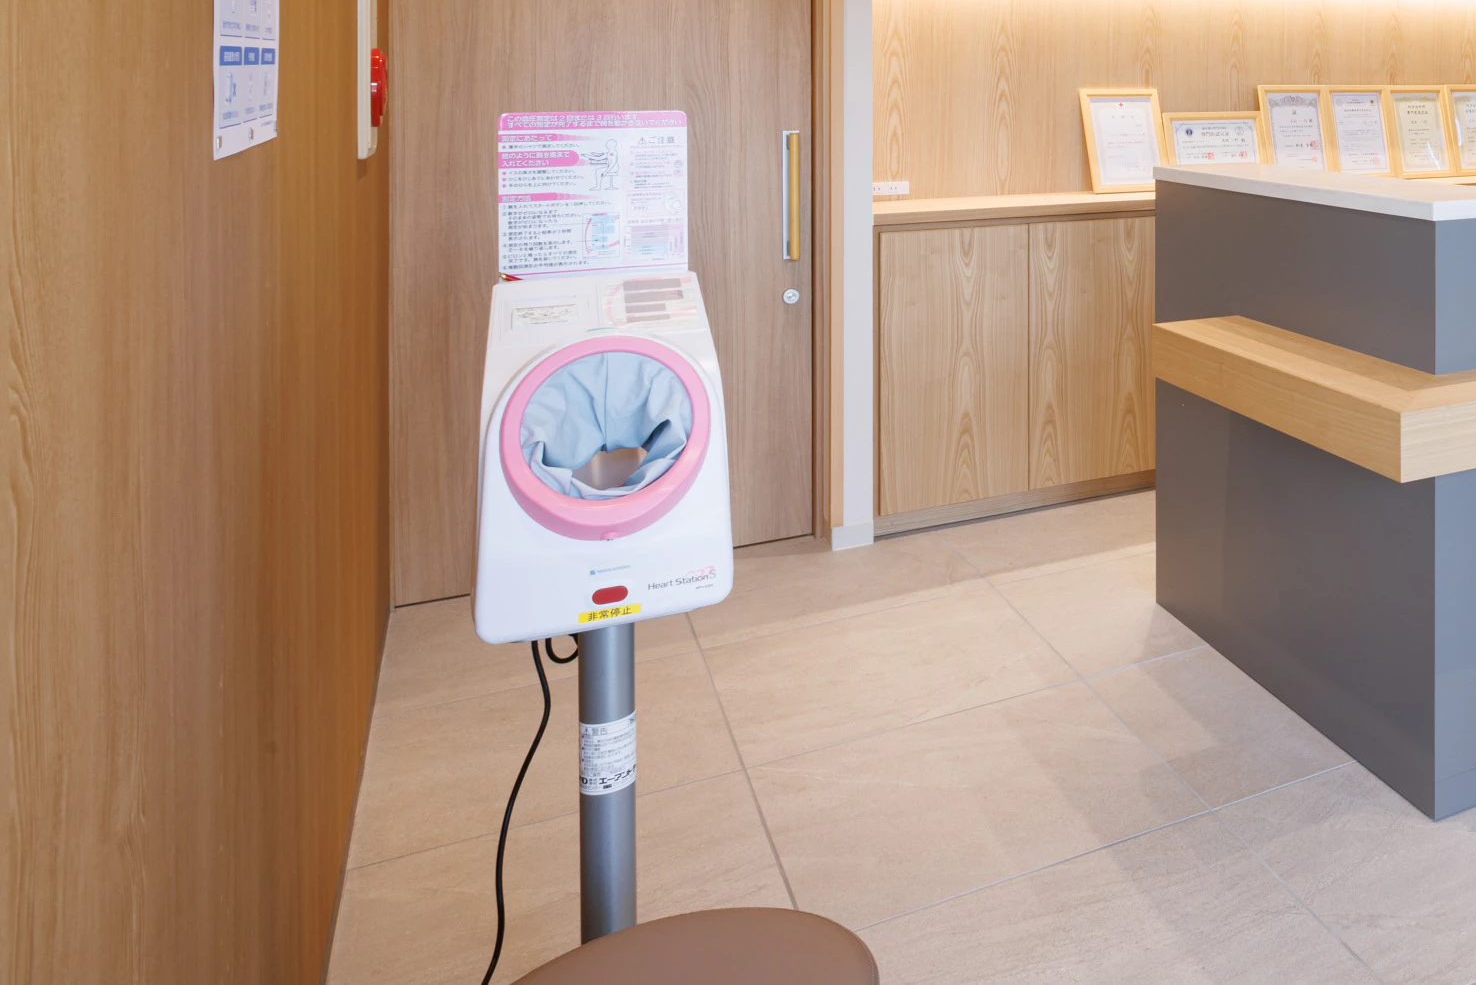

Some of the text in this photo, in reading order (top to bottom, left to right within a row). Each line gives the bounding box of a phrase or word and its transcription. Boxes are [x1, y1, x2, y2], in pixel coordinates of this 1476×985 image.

[648, 135, 676, 144] ご注意
[501, 159, 549, 168] 入れてください
[647, 579, 673, 591] Heart
[675, 573, 709, 586] Station
[587, 605, 633, 623] 非常停止
